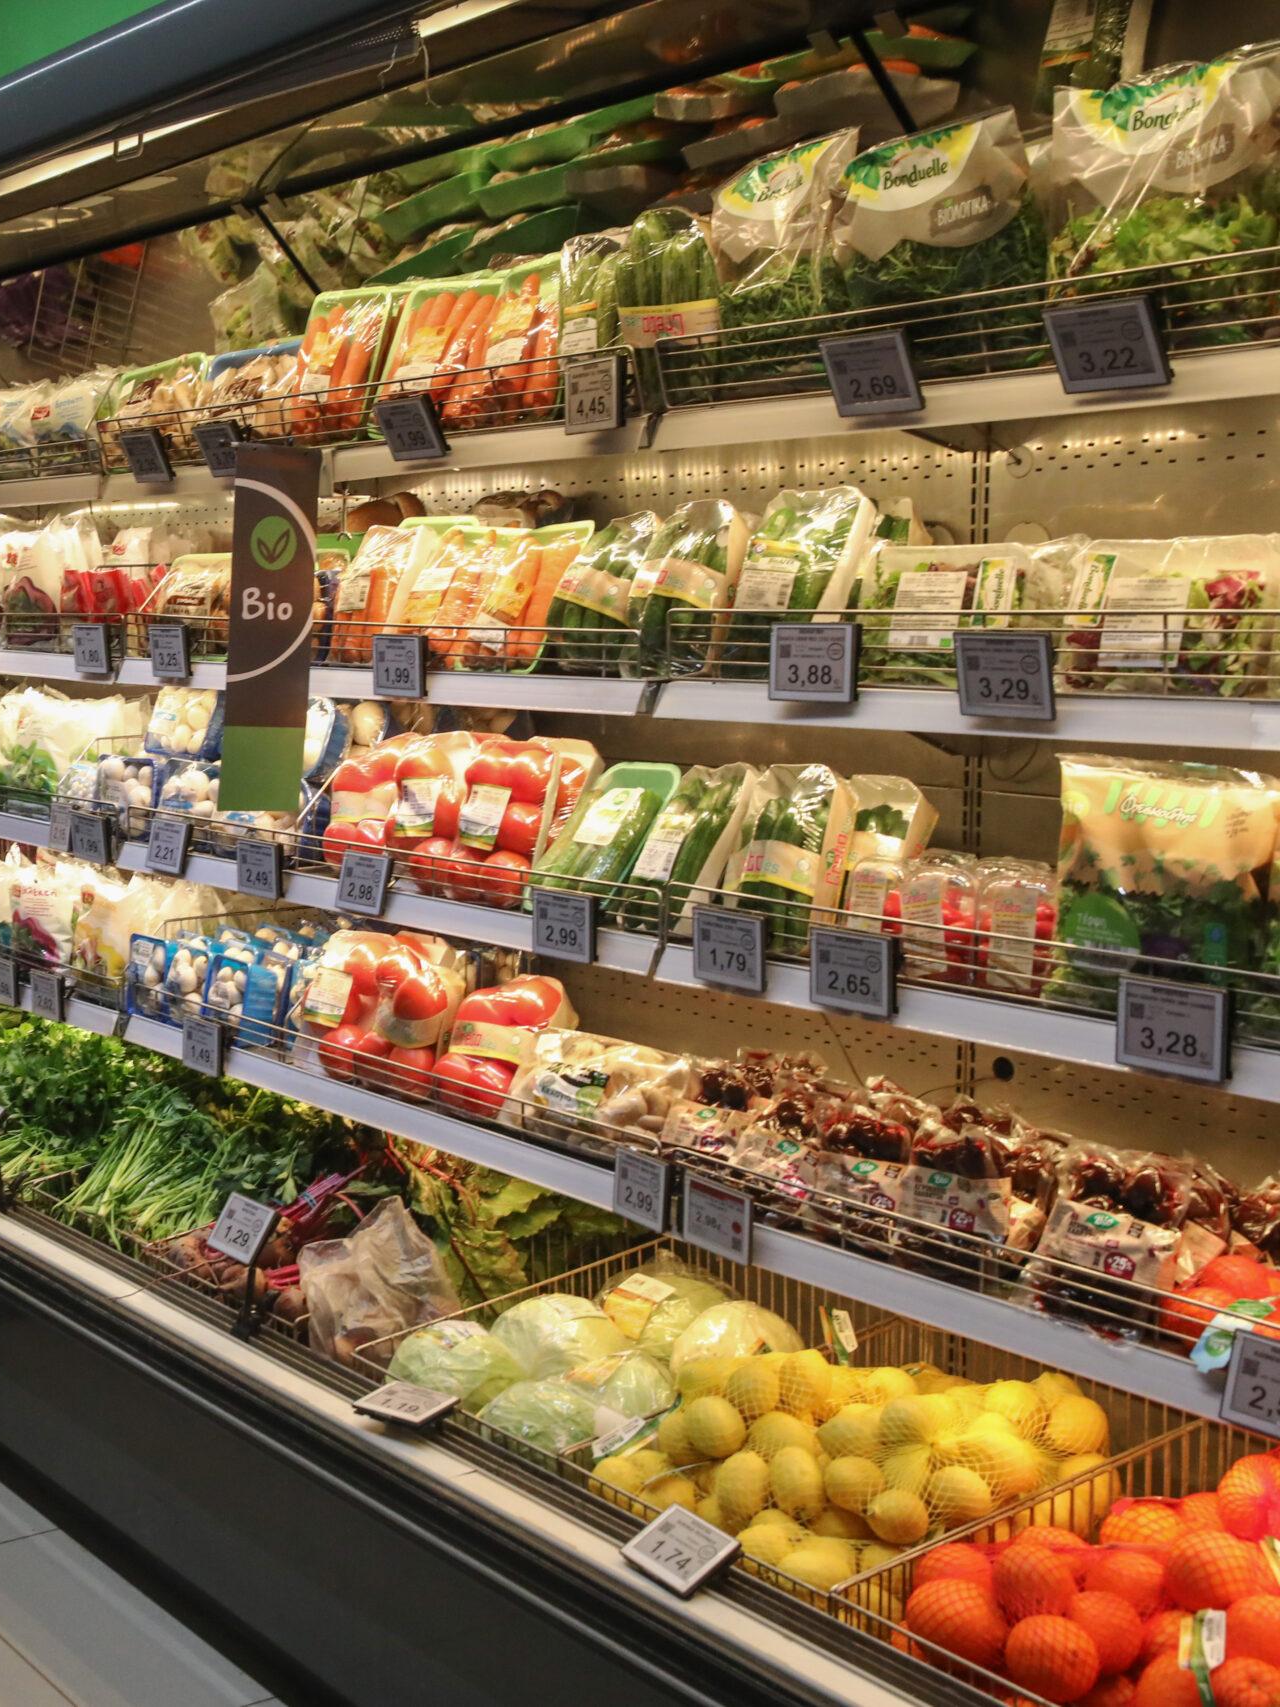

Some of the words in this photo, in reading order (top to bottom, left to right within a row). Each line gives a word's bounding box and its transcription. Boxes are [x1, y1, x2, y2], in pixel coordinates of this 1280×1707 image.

[883, 157, 949, 190] Bonduelle
[1078, 346, 1138, 376] 3,22
[849, 375, 898, 400] 2,69
[576, 396, 607, 418] 4,45
[241, 587, 294, 622] Bio
[158, 651, 179, 667] 3,25
[384, 667, 410, 685] 1,99
[787, 664, 833, 688] 3,88
[979, 676, 1030, 702] 3,29
[154, 844, 175, 861] 2,21
[245, 868, 268, 886] 2,49
[346, 882, 373, 901] 2,98
[545, 925, 578, 946] 2,99
[709, 948, 747, 972] 1,79
[827, 970, 872, 996] 2,65
[1140, 1025, 1198, 1058] 3,28
[190, 1045, 210, 1063] 1,49
[624, 1185, 655, 1213] 2,99
[1093, 1214, 1114, 1227] Bio
[224, 1225, 251, 1247] 1,29
[1106, 1255, 1133, 1272] +25%
[1249, 1385, 1280, 1418] 2,
[651, 1539, 695, 1572] 1,74
